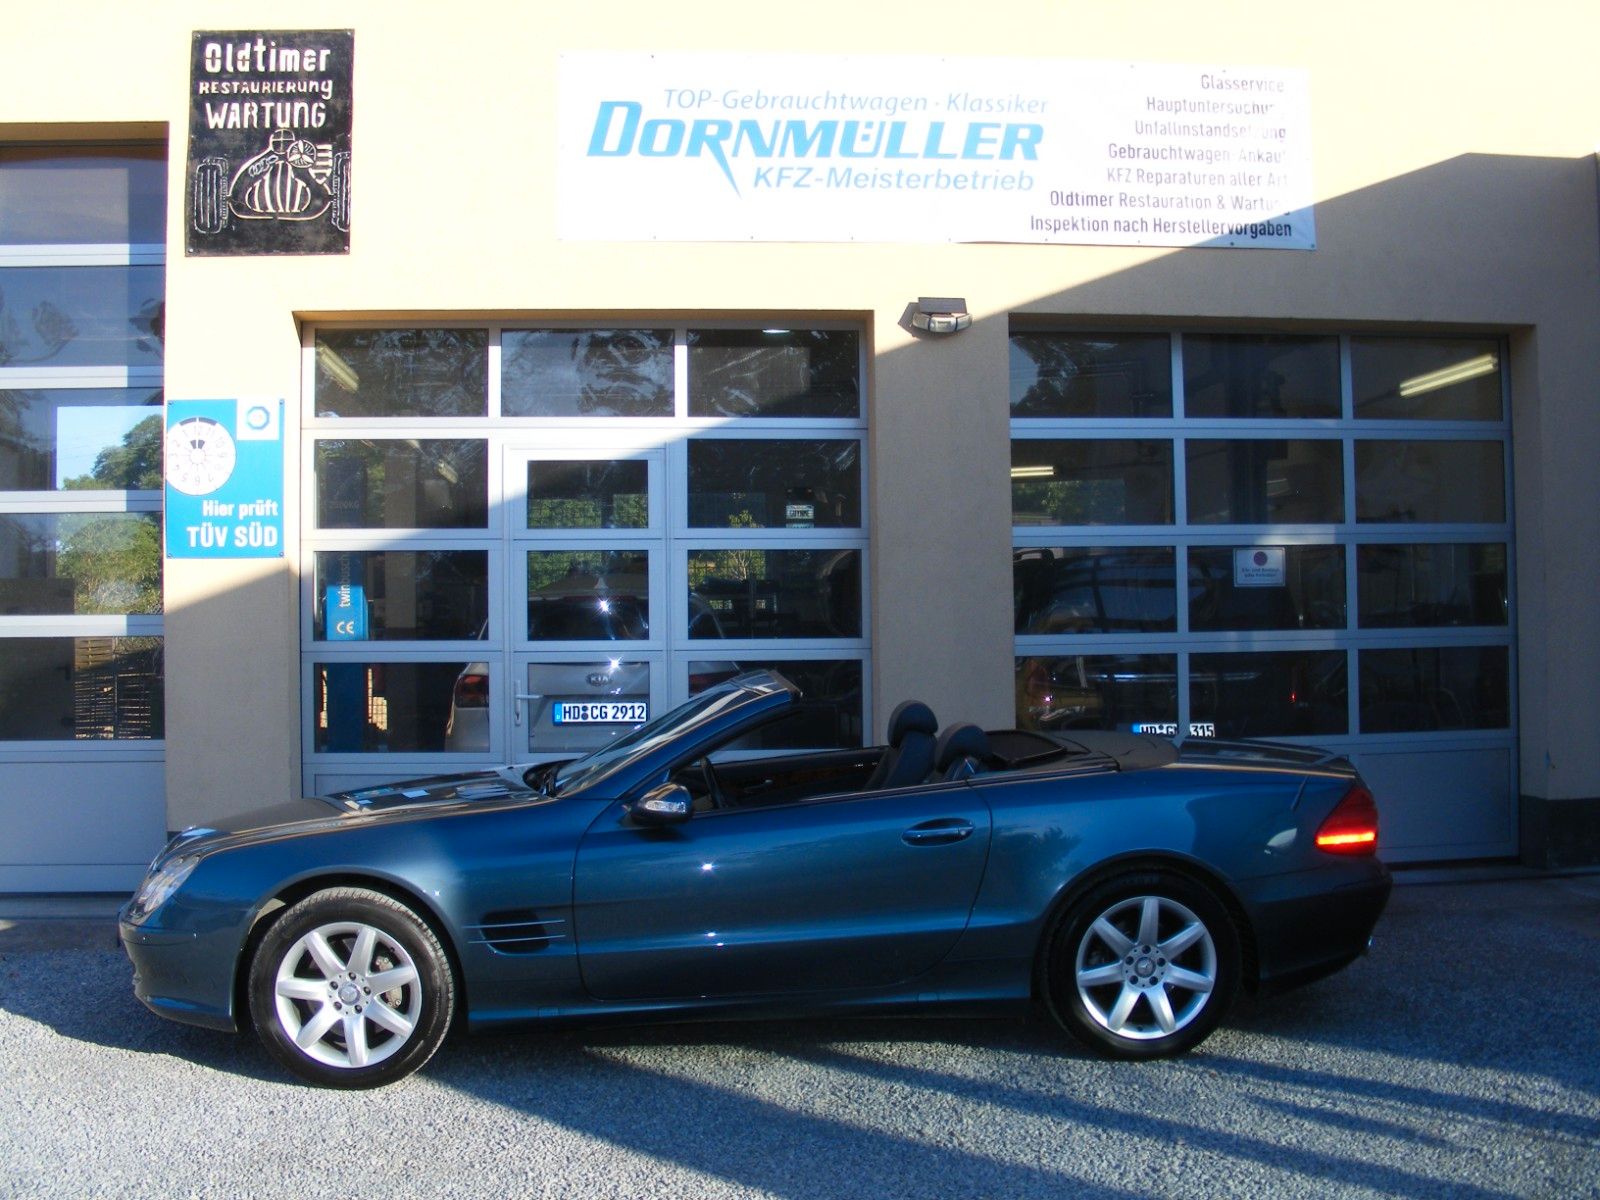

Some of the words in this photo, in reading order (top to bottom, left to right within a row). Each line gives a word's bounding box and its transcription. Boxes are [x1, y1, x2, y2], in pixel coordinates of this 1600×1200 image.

[205, 39, 331, 73] Oldtimer
[1200, 74, 1285, 93] Glasservice
[664, 88, 928, 114] TOP-Gebrauchtwagen
[946, 92, 1048, 115] Klassiker
[753, 165, 1034, 192] KFZ-Meisterbetrieb
[1107, 167, 1132, 184] KFZ
[1136, 168, 1225, 188] Reparaturen
[1230, 171, 1262, 187] aller
[1050, 190, 1113, 208] Oldtimer
[1119, 192, 1212, 210] Restauration
[1217, 194, 1226, 210] &
[1030, 215, 1109, 234] Inspektion
[1113, 217, 1149, 234] nach
[1153, 218, 1293, 239] Herstellervorgaben
[202, 499, 235, 517] Hier
[238, 499, 279, 520] prüft
[187, 520, 228, 548] TÜV
[234, 520, 279, 548] SÜD
[611, 705, 645, 720] 2912
